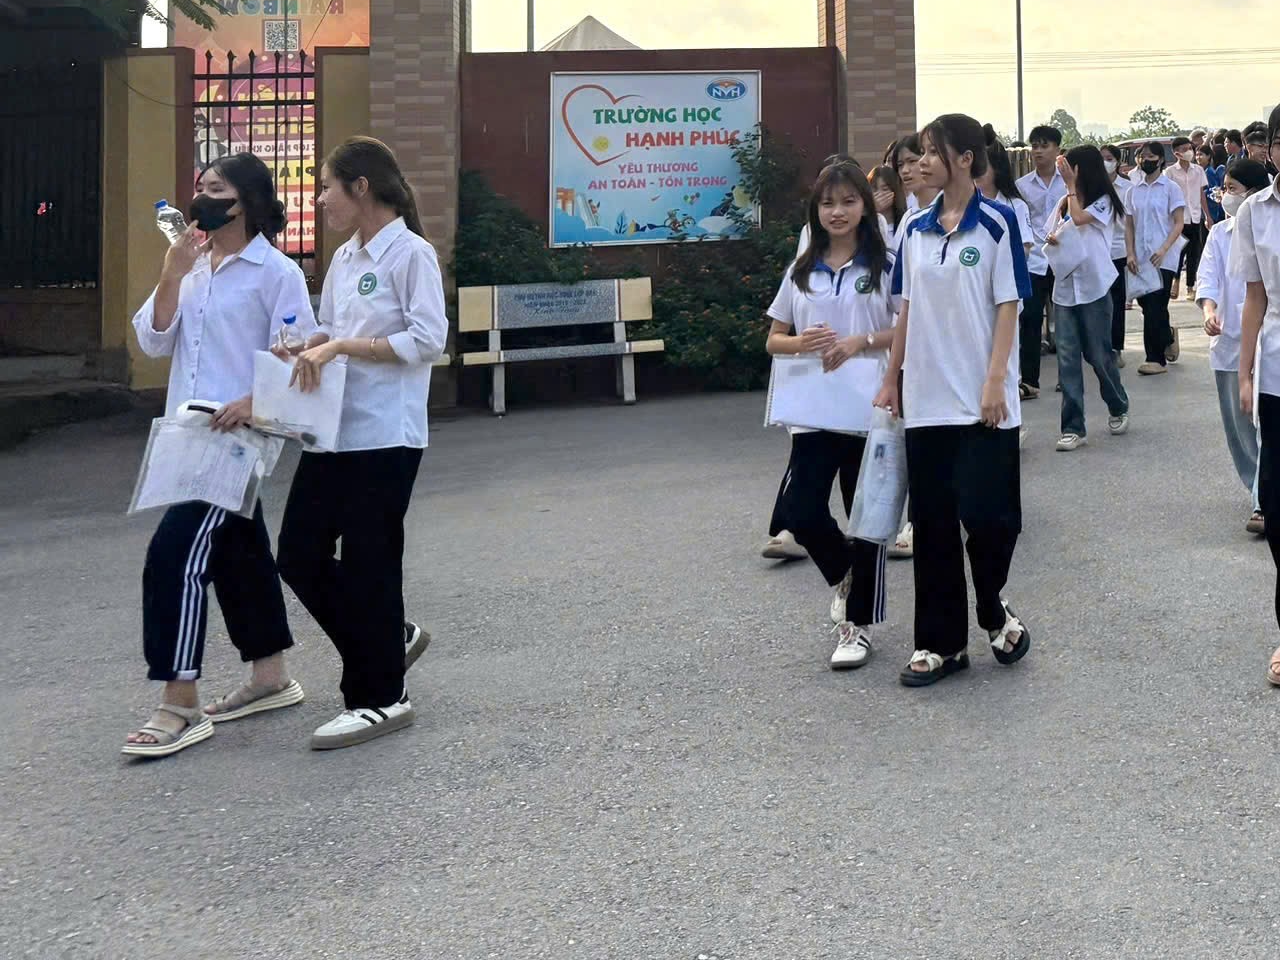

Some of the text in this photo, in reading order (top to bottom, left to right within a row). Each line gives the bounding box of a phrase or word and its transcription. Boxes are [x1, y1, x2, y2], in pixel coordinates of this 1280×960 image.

[593, 105, 722, 126] TRƯỜNG HỌC
[626, 131, 684, 150] HẠNH
[618, 162, 699, 174] YÊU THƯƠNG
[588, 179, 608, 190] AN
[611, 177, 647, 189] TOÀN
[659, 177, 683, 187] TÔN
[687, 175, 728, 188] TRỌNG
